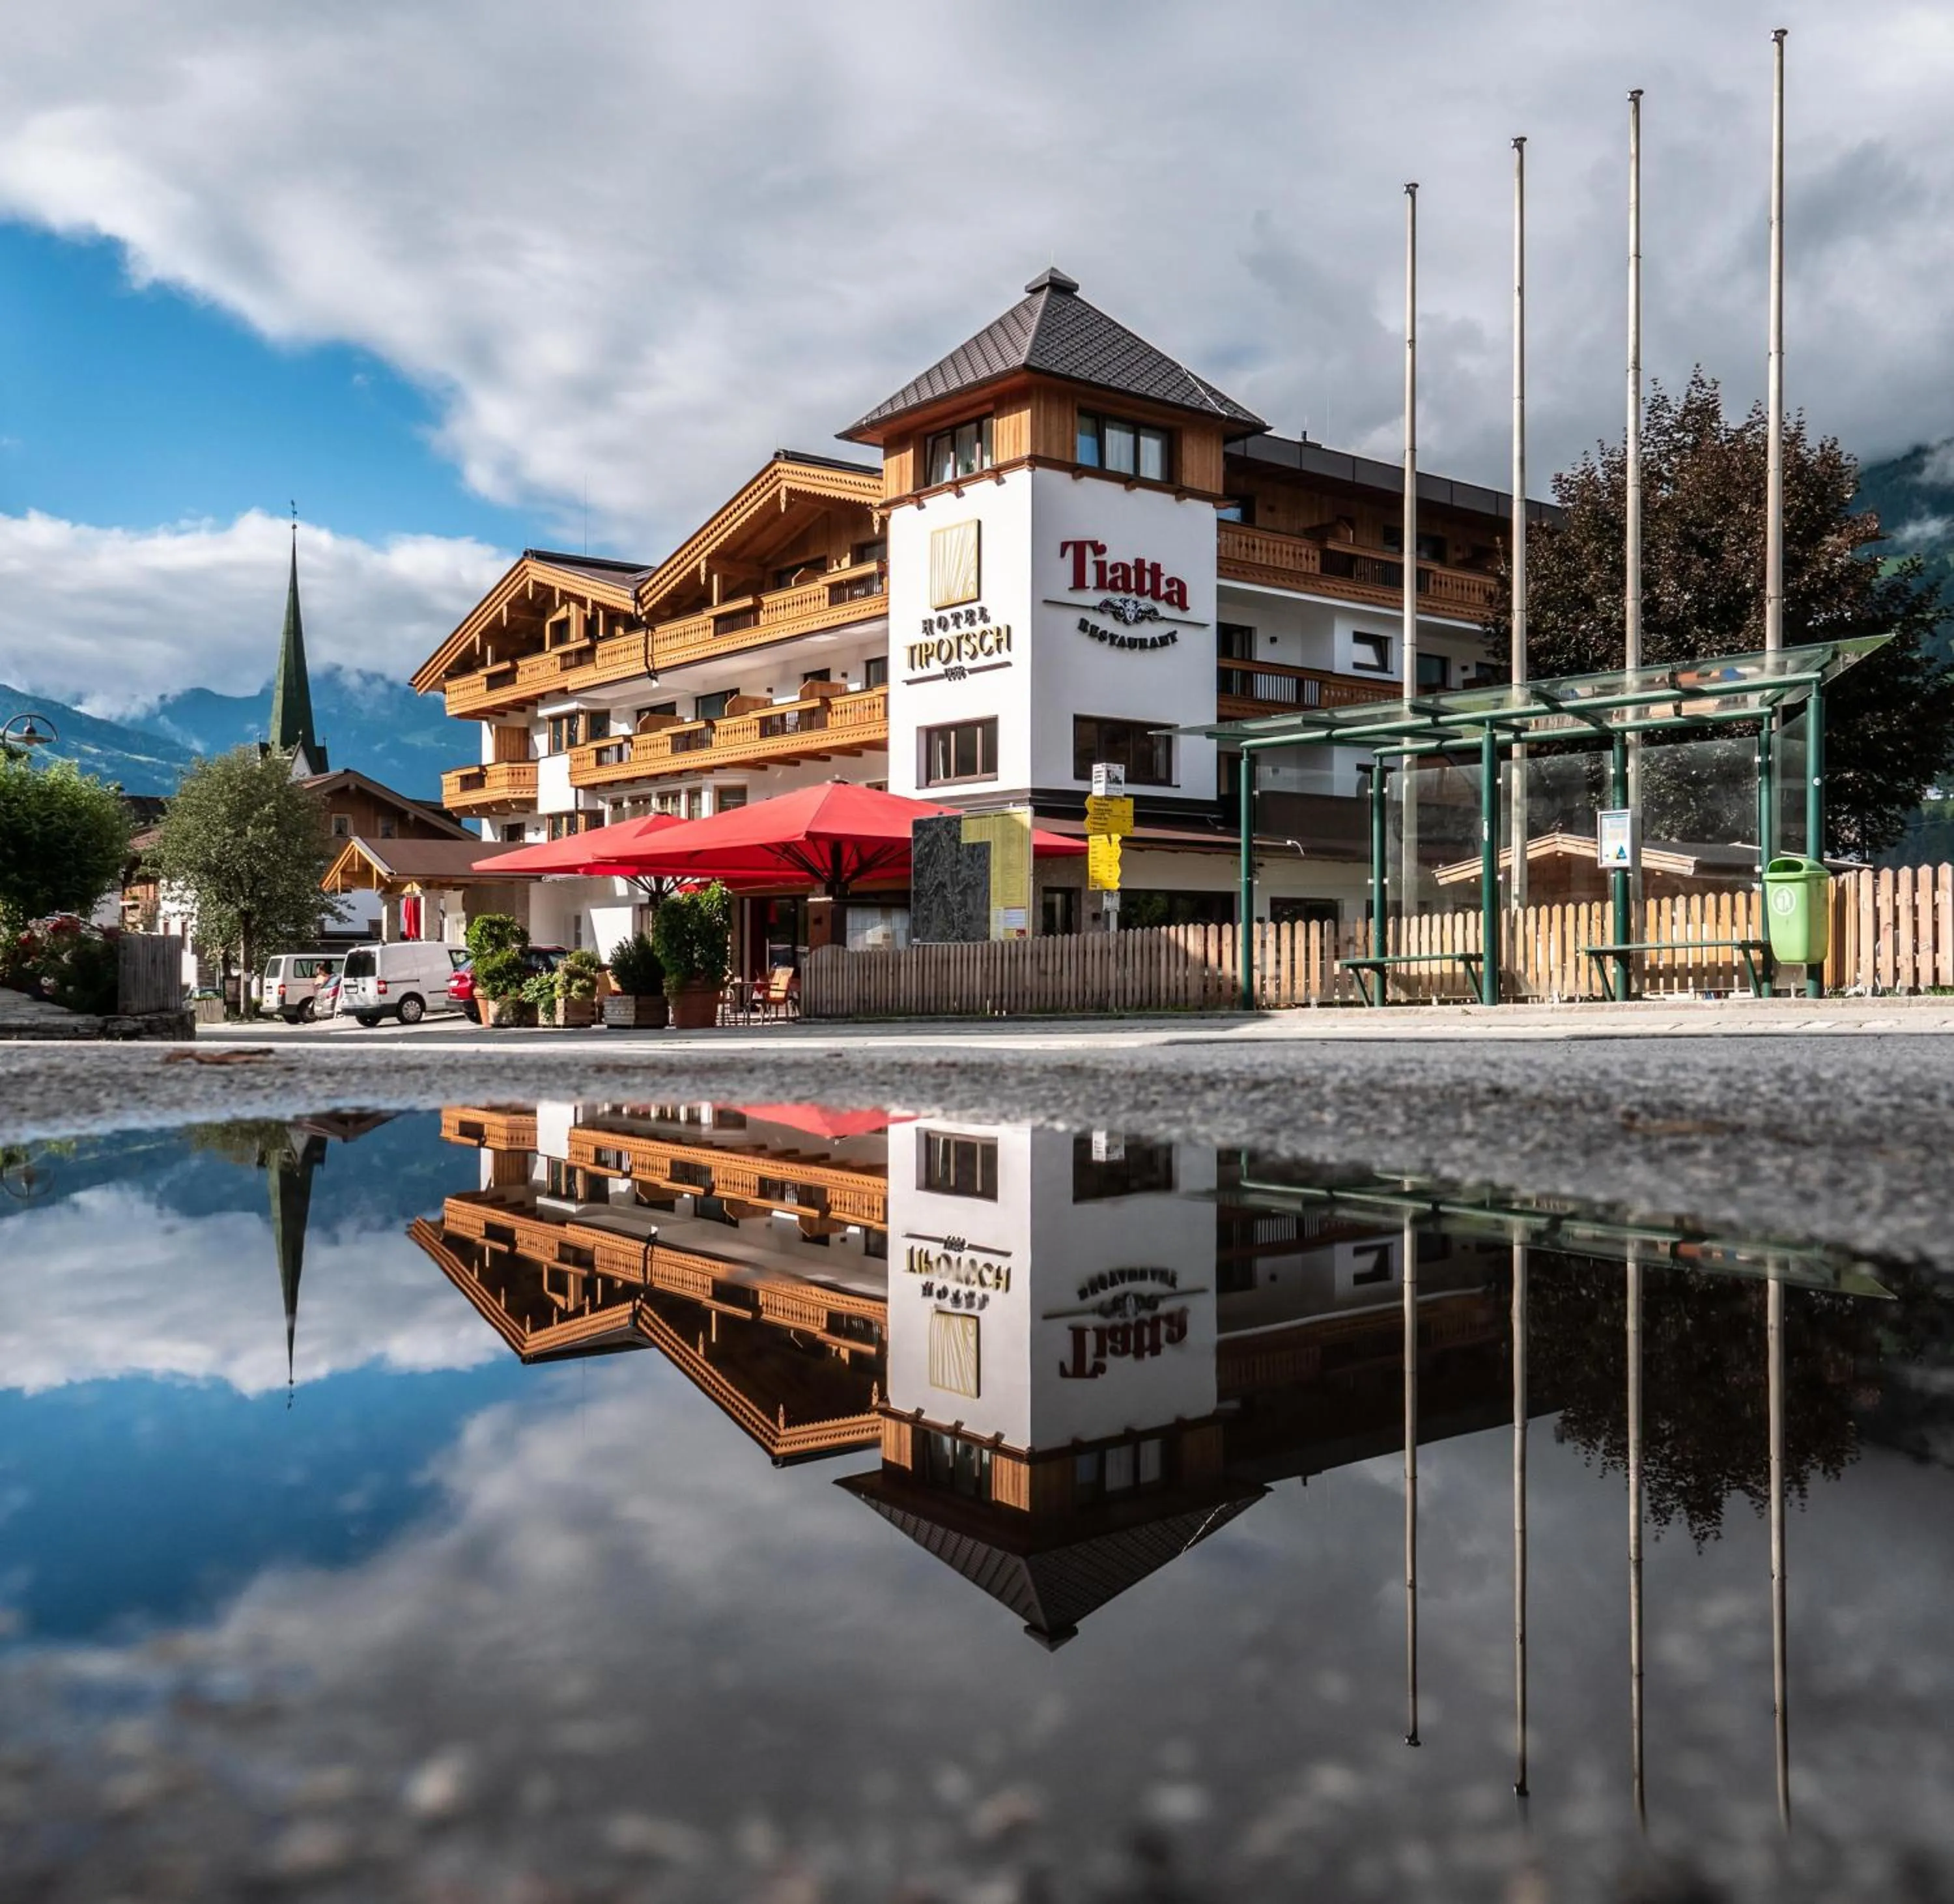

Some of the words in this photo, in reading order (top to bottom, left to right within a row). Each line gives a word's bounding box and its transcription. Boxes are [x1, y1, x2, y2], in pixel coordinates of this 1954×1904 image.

[1060, 540, 1190, 611] Tiatta
[922, 606, 990, 636] HOTEL
[1077, 617, 1178, 650] RESTAURANT
[904, 623, 1012, 671] TIPOTSCH
